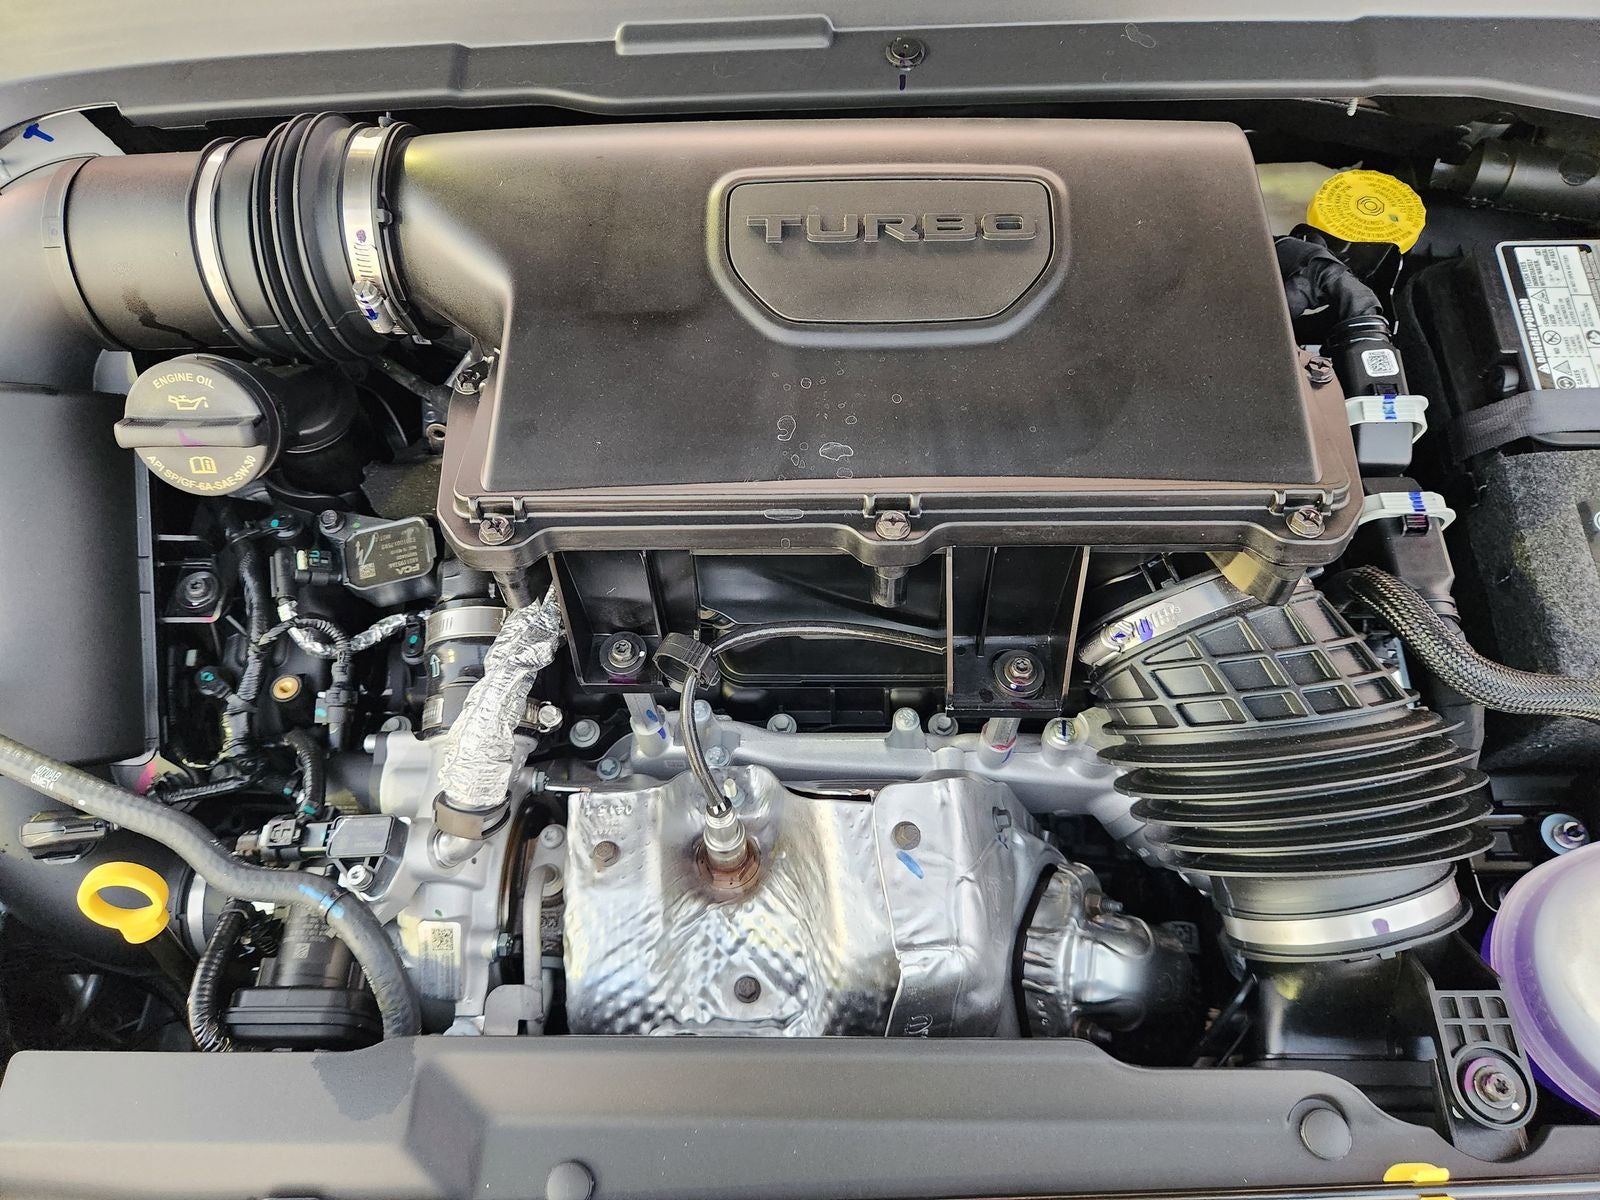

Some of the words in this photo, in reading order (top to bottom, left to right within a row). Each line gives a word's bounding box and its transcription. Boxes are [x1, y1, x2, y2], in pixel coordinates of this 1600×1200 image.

[746, 213, 1036, 243] TURBO
[1518, 298, 1546, 363] DANGER/POISON
[152, 372, 193, 389] ENGINE
[196, 375, 215, 390] OIL
[146, 455, 165, 472] API
[395, 563, 421, 575] FCA
